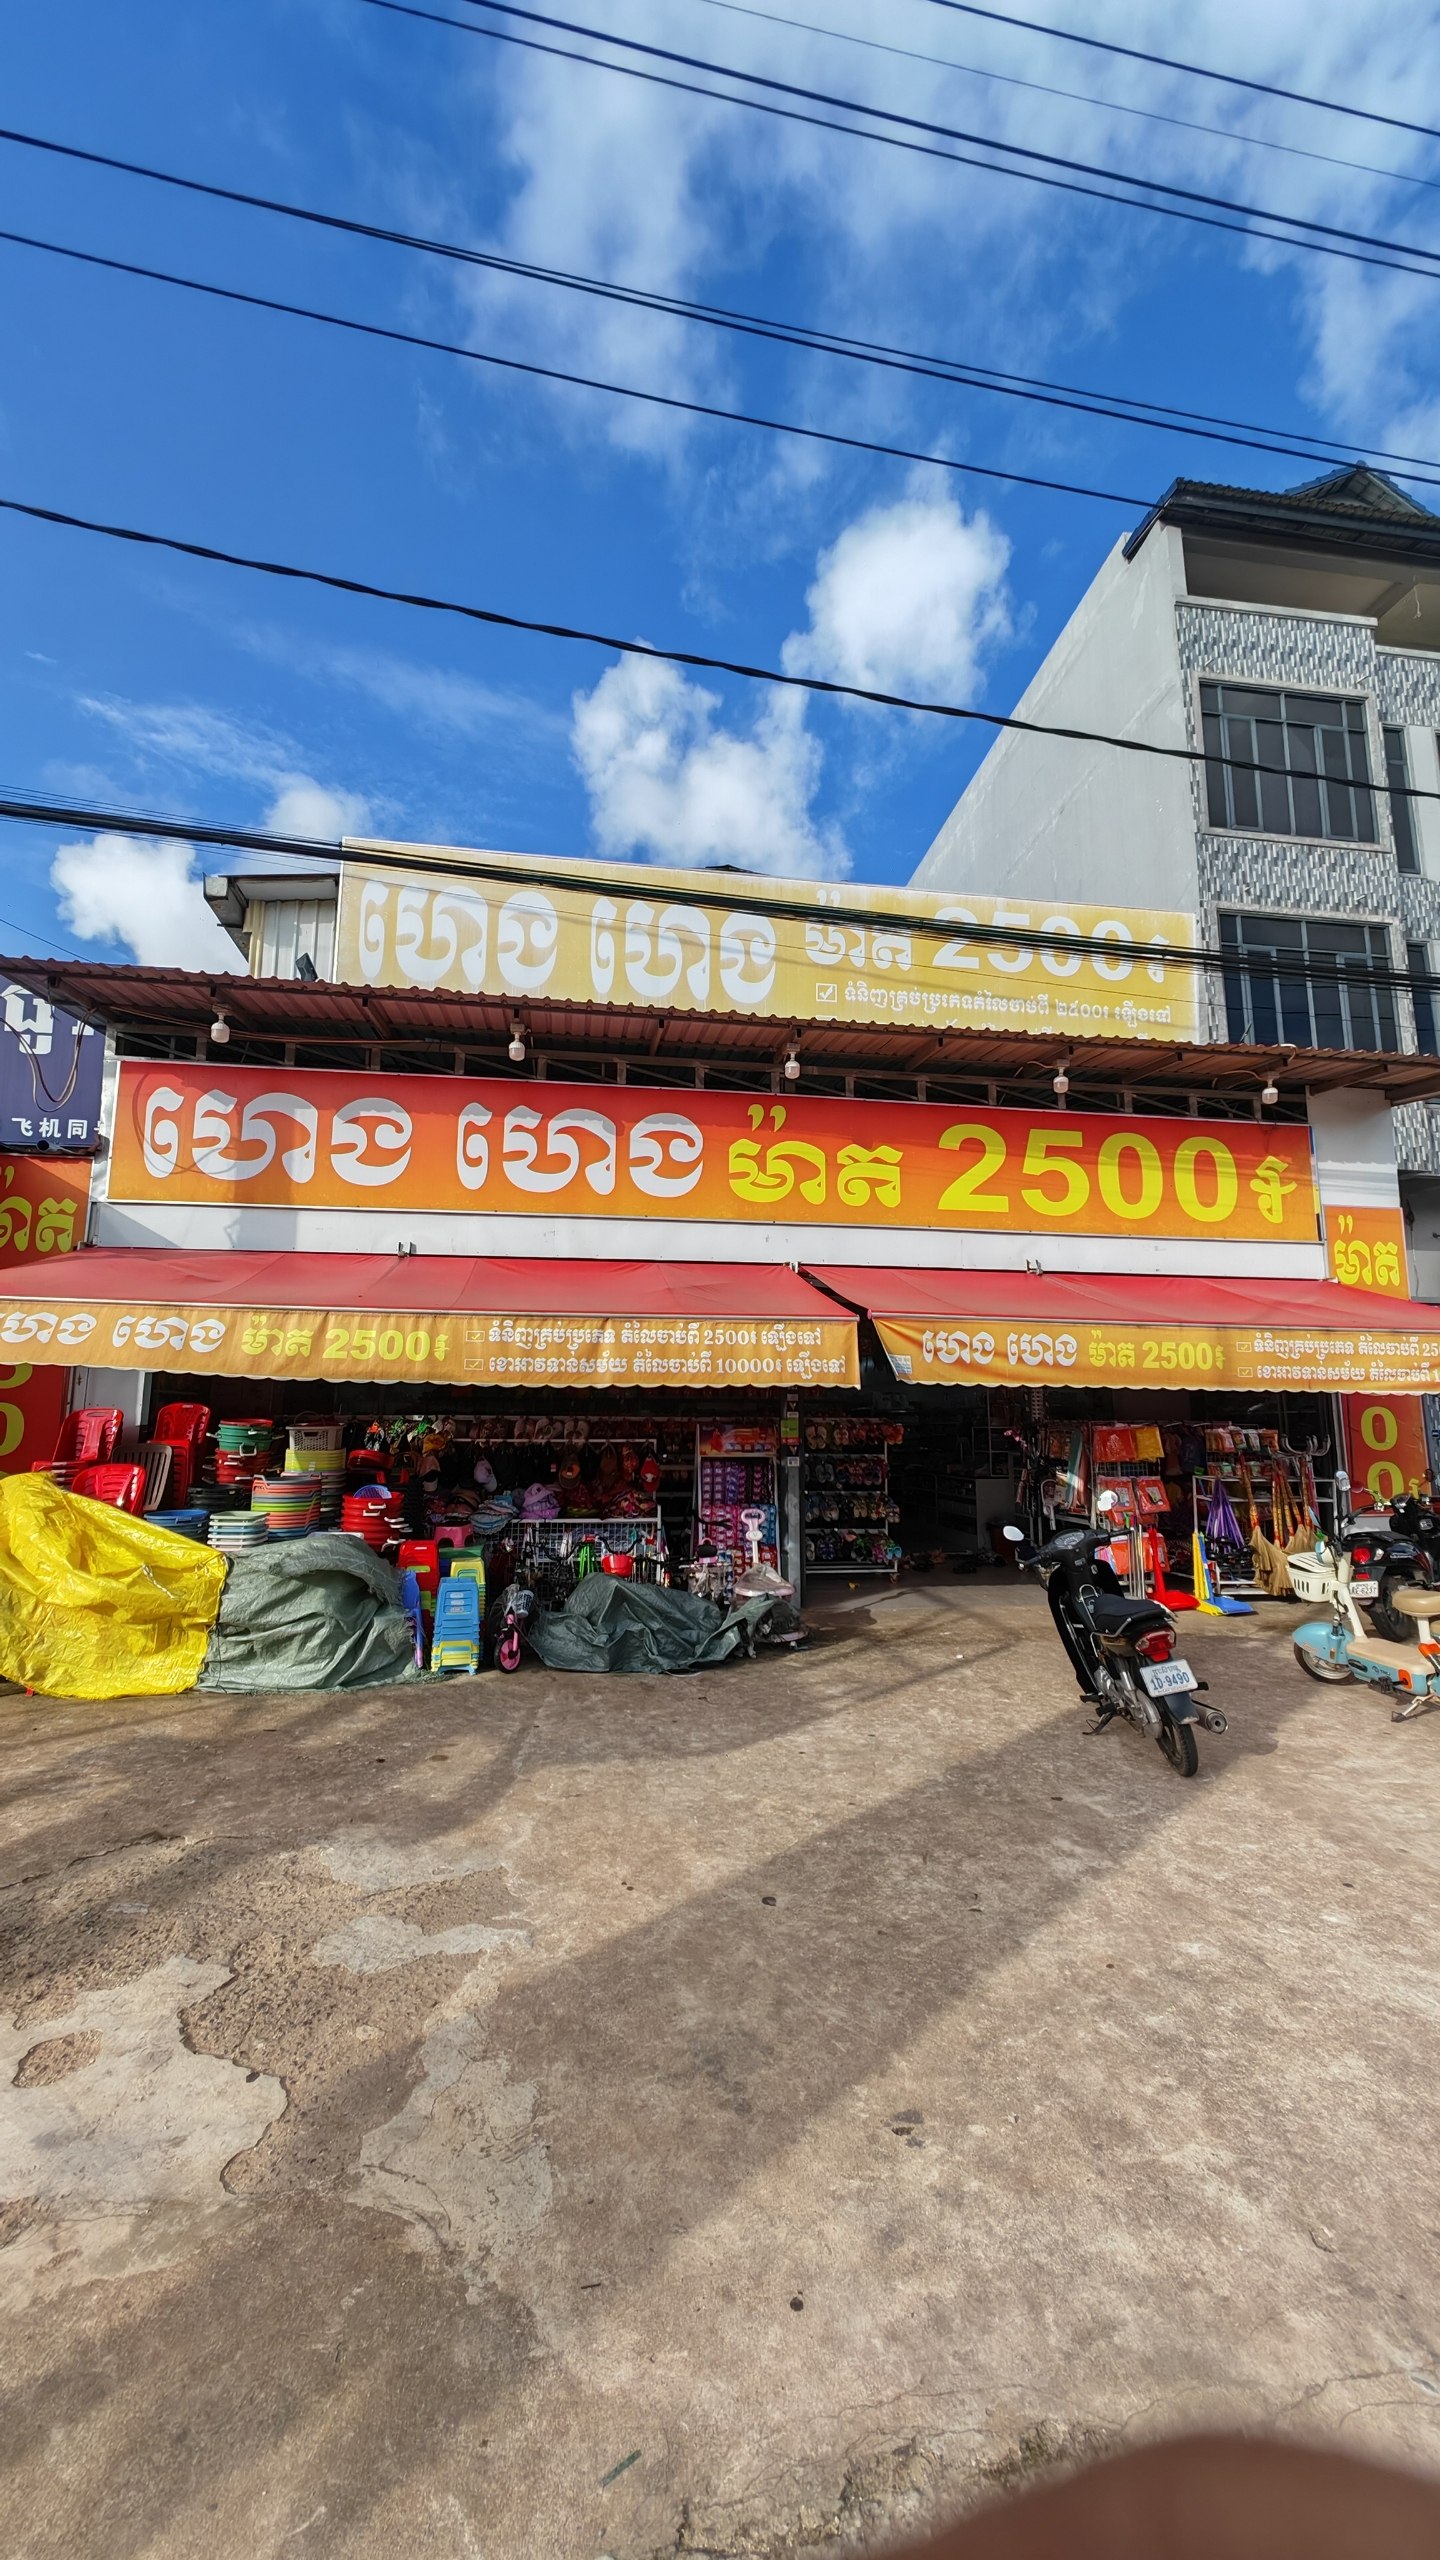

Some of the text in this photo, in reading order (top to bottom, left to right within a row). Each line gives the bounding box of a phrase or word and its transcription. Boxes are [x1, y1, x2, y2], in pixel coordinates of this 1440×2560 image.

[144, 1087, 412, 1186] ហេង
[456, 1102, 704, 1197] ហេង
[112, 1315, 226, 1353] ហេង
[922, 1330, 995, 1365] ហេង
[1007, 1332, 1078, 1367] ហេង
[1422, 1342, 1440, 1357] 25
